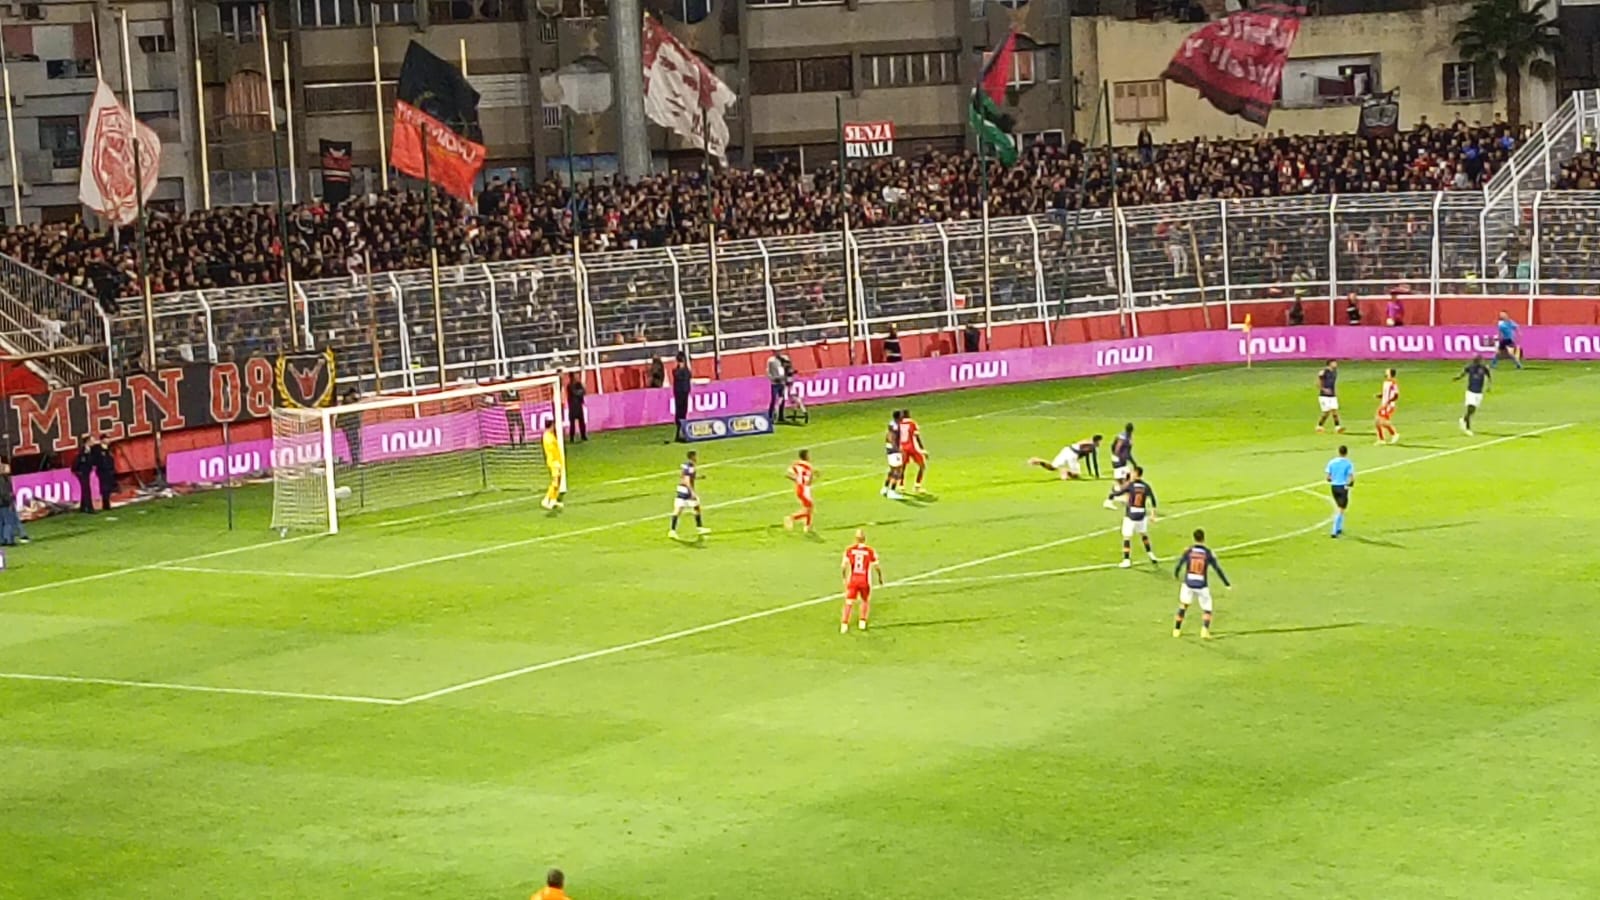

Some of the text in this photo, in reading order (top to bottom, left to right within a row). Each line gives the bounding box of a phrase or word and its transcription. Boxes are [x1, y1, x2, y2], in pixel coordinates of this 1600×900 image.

[1444, 335, 1499, 352] inw
[10, 357, 274, 455] MEN 08
